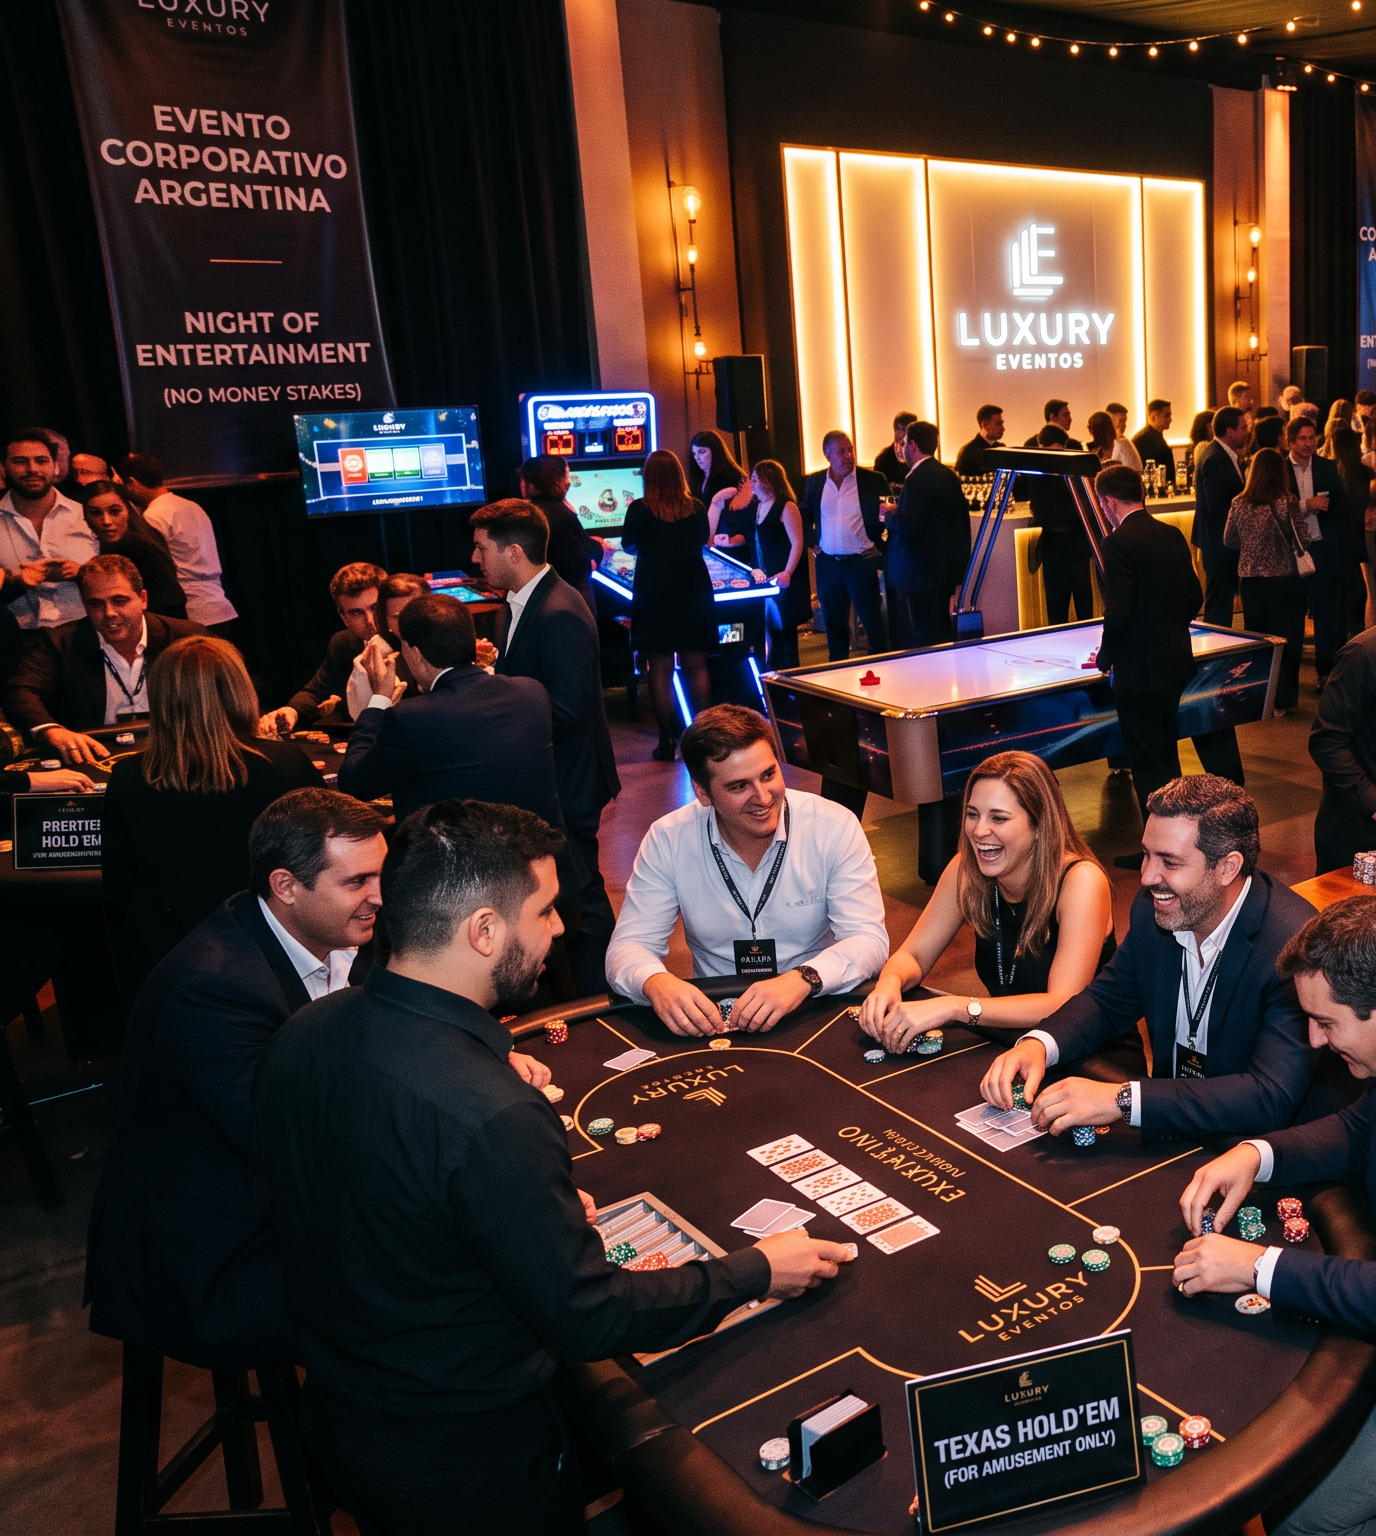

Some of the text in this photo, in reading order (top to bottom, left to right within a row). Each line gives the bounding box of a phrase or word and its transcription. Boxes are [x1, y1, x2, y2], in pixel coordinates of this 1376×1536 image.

[166, 17, 248, 37] EVENTOS
[153, 104, 291, 141] EVENTO
[100, 137, 348, 180] CORPORATIVO
[134, 178, 332, 213] ARGENTINA
[184, 311, 319, 334] NIGHT OF
[957, 312, 1116, 347] LUXURY
[135, 342, 371, 367] ENTERTAINMENT
[996, 352, 1084, 371] EVENTOS
[163, 382, 362, 409] (NO MONEY STAKES)
[42, 835, 79, 848] HOLD
[632, 1064, 745, 1106] LUXURY
[958, 1271, 1089, 1344] LUXURY
[997, 1294, 1086, 1342] EVENTOS
[933, 1396, 1120, 1464] TEXAS HOLD'EM
[944, 1429, 1116, 1489] (FOR AMUSEMENT ONLY)
